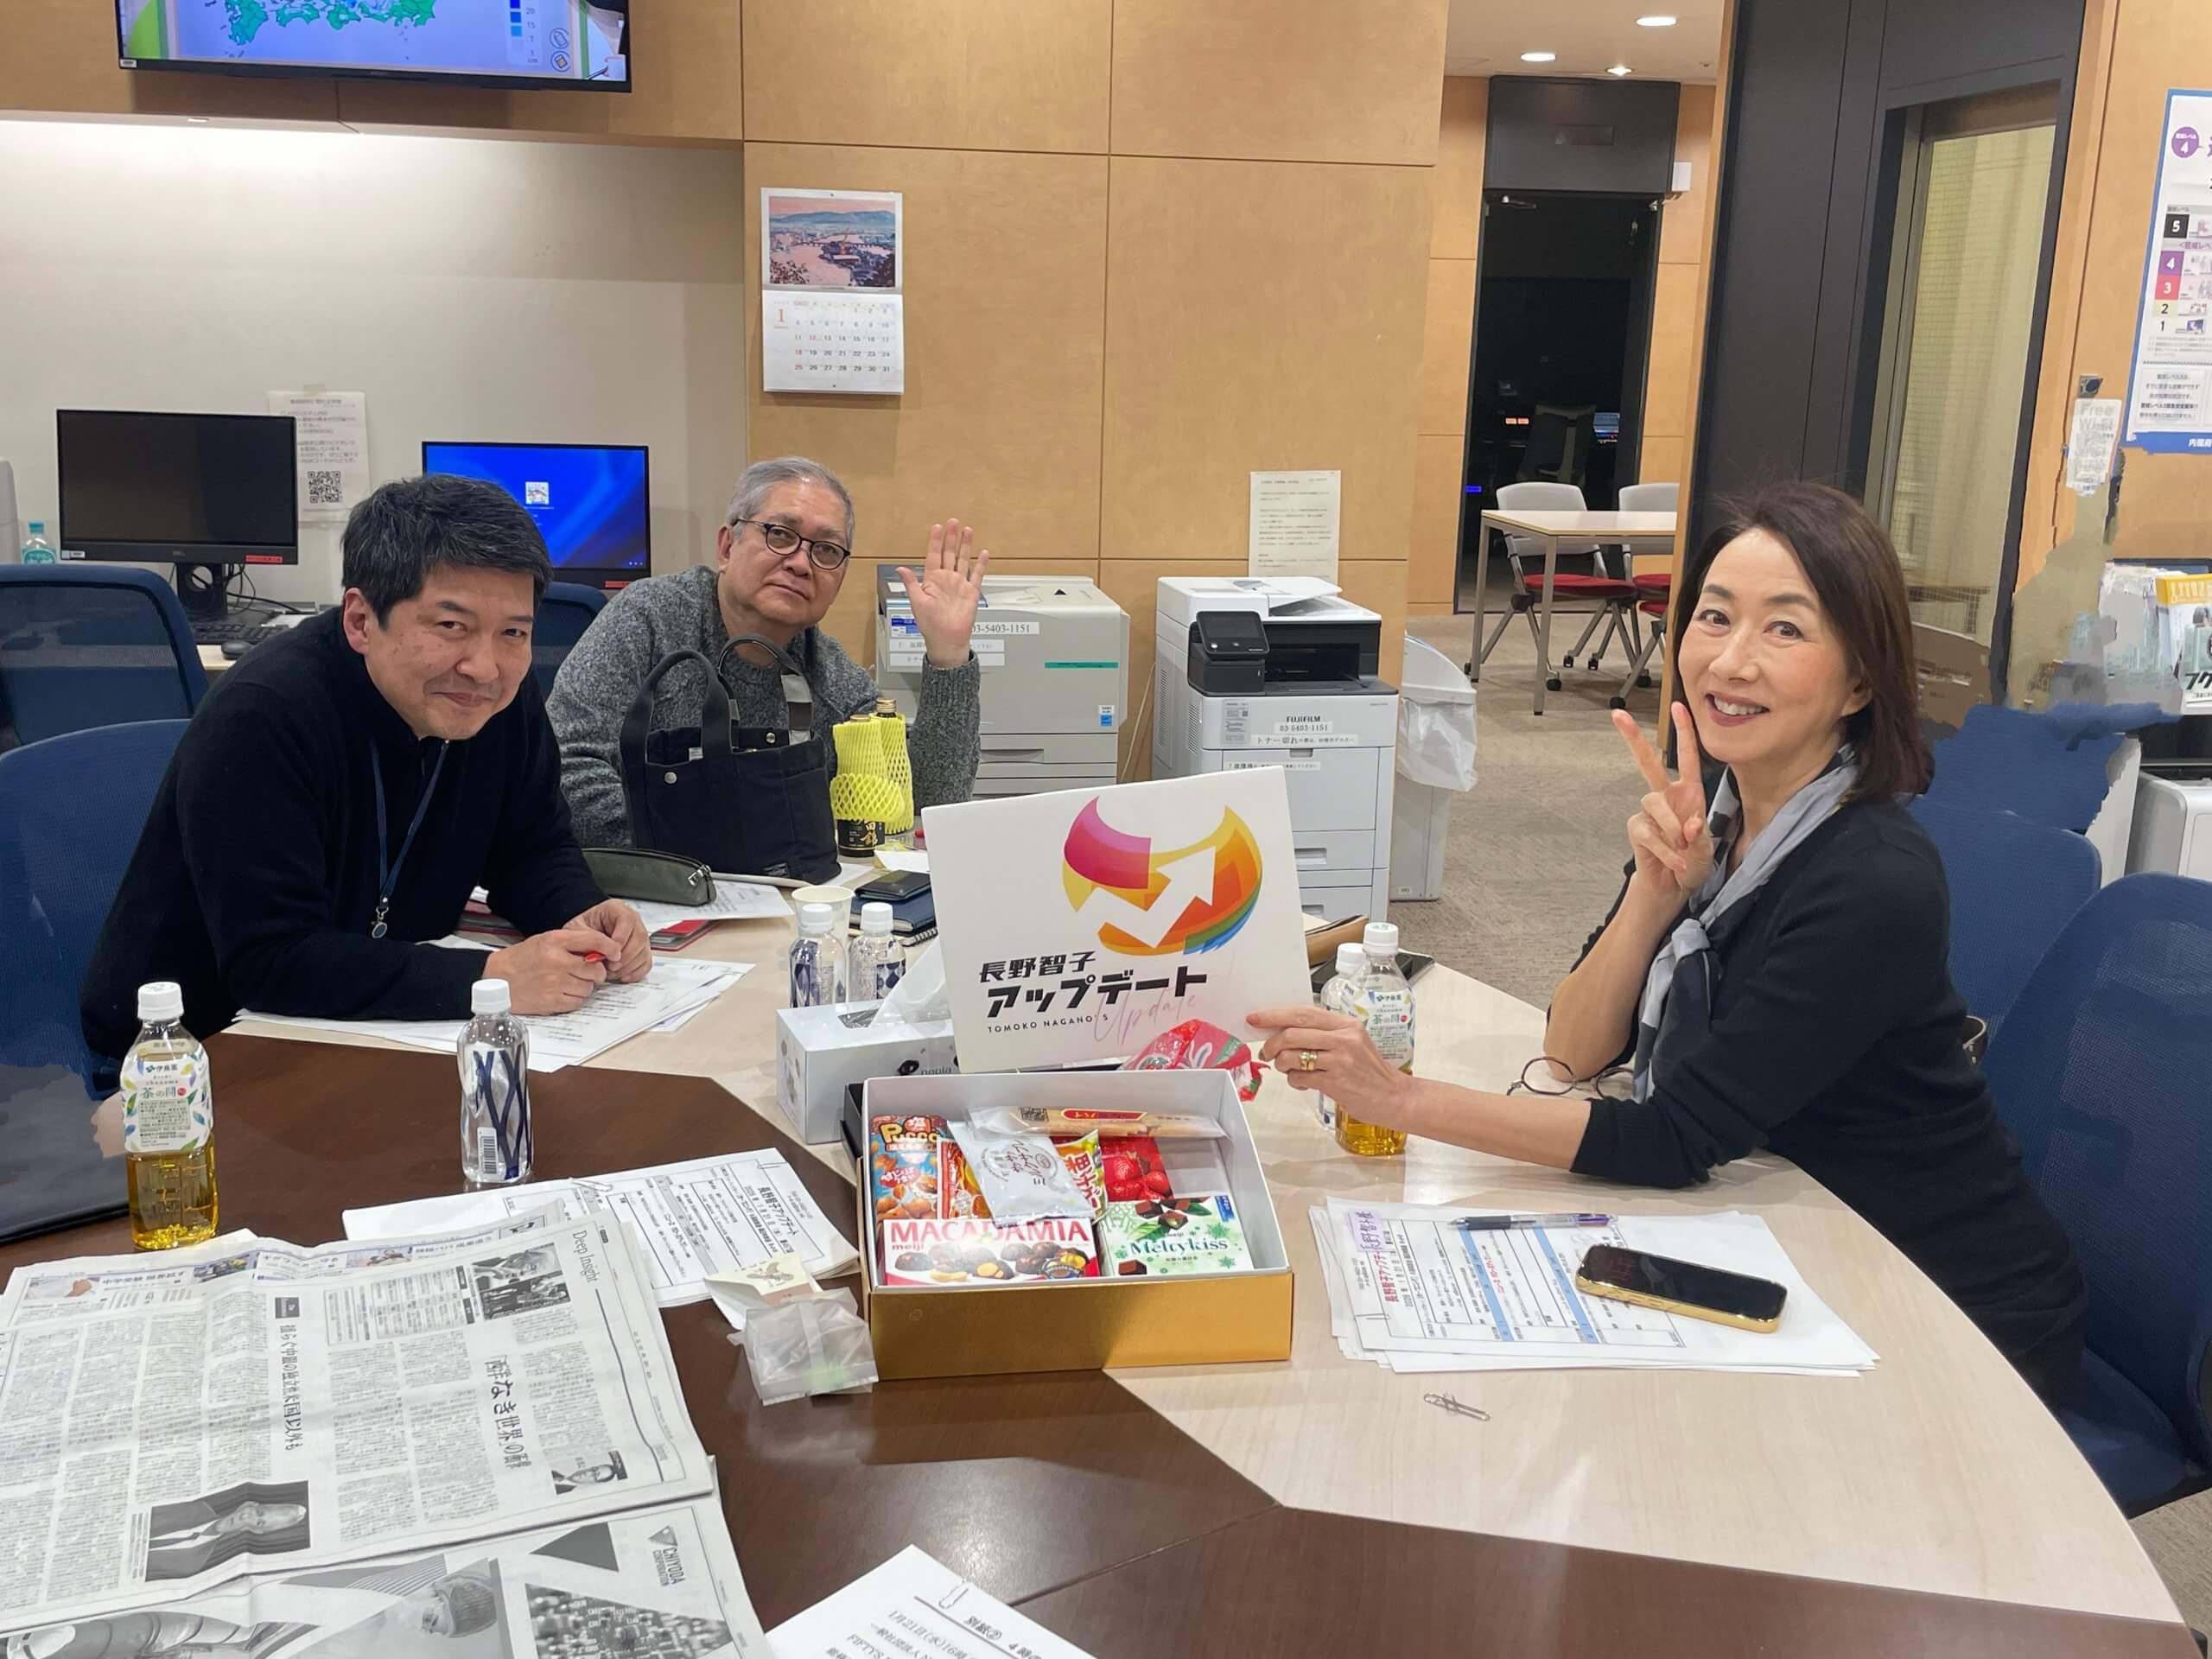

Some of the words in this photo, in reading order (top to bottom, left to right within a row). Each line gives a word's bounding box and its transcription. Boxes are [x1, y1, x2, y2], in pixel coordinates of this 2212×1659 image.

[2181, 142, 2189, 154] 4
[2172, 220, 2181, 232] 5
[2166, 257, 2175, 270] 4
[2164, 283, 2171, 294] 3
[779, 308, 784, 322] 1
[2161, 304, 2169, 314] 2
[2160, 321, 2164, 332] 1
[979, 950, 1096, 983] 長野智子
[987, 965, 1208, 1019] アップデート
[988, 1021, 1038, 1033] TOMOKO
[890, 1220, 1090, 1243] MACADAMIA
[573, 1230, 591, 1255] Deep
[892, 1243, 925, 1252] meiji
[1130, 1237, 1229, 1255] Meltykiss
[581, 1253, 601, 1283] Insight
[662, 1546, 686, 1585] CHIYODA
